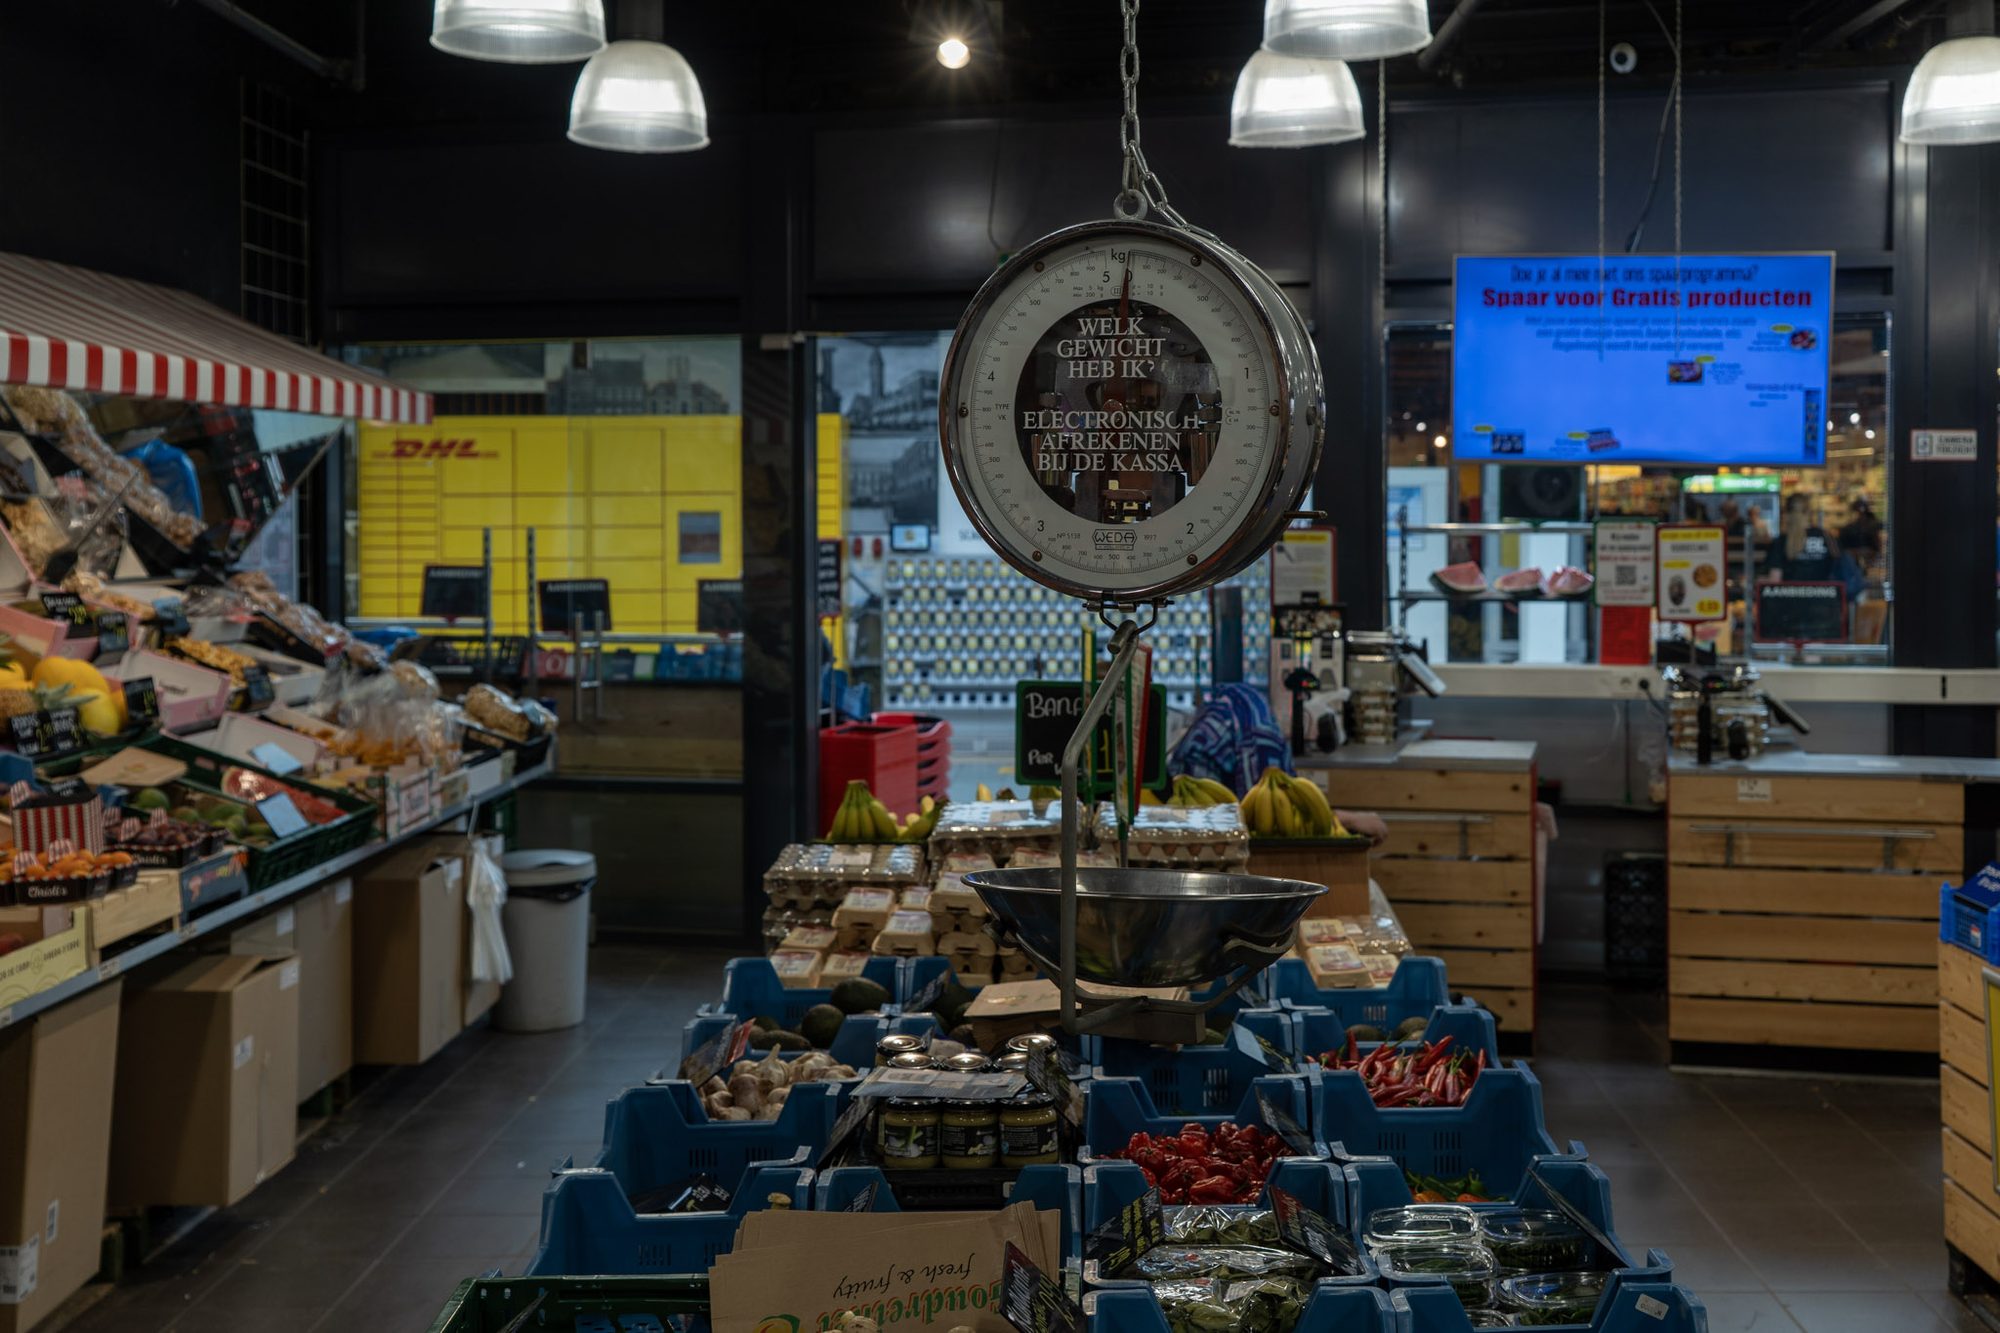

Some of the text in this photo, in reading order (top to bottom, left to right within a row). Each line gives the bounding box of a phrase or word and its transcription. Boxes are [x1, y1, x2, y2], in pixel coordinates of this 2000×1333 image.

[1111, 248, 1126, 264] kg
[1102, 271, 1110, 282] 5
[1482, 288, 1812, 308] Spaar voor Gratis producten
[1078, 317, 1146, 336] WELK
[1057, 338, 1166, 358] GEWICHT
[988, 371, 995, 381] 4
[1068, 360, 1116, 378] HEB
[1244, 367, 1249, 379] 1
[1023, 410, 1200, 430] ELECTRONISCH
[390, 438, 480, 458] DHL
[1040, 432, 1182, 450] AFREKENEN
[1038, 453, 1184, 472] BIJ DE KASSA
[1037, 520, 1044, 532] 3
[1186, 522, 1194, 534] 2
[1094, 532, 1135, 543] WEDA
[833, 1252, 976, 1299] fresh & fruity
